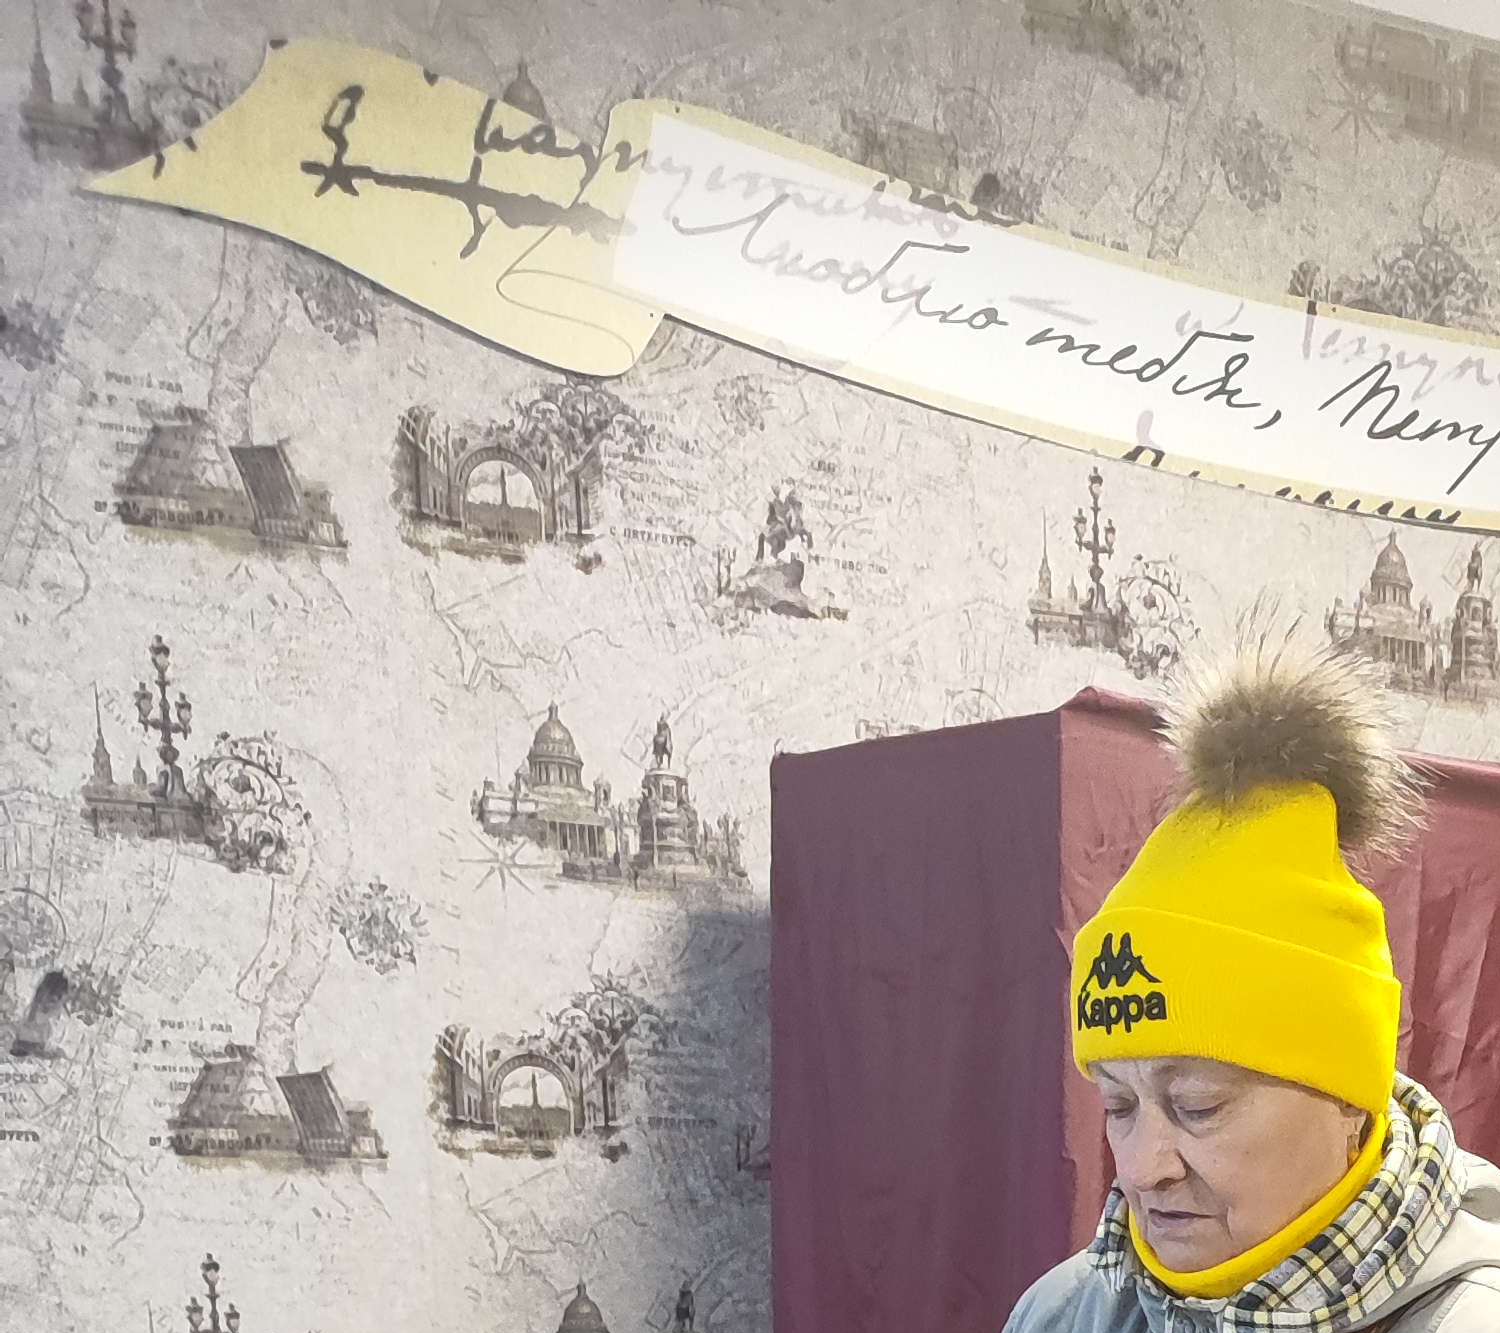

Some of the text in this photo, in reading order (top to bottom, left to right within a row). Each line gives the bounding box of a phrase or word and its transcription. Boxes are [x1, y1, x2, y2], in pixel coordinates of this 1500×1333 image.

[672, 193, 1009, 330] Люблю
[1026, 329, 1283, 430] тебя,
[1077, 990, 1168, 1035] Kappa
